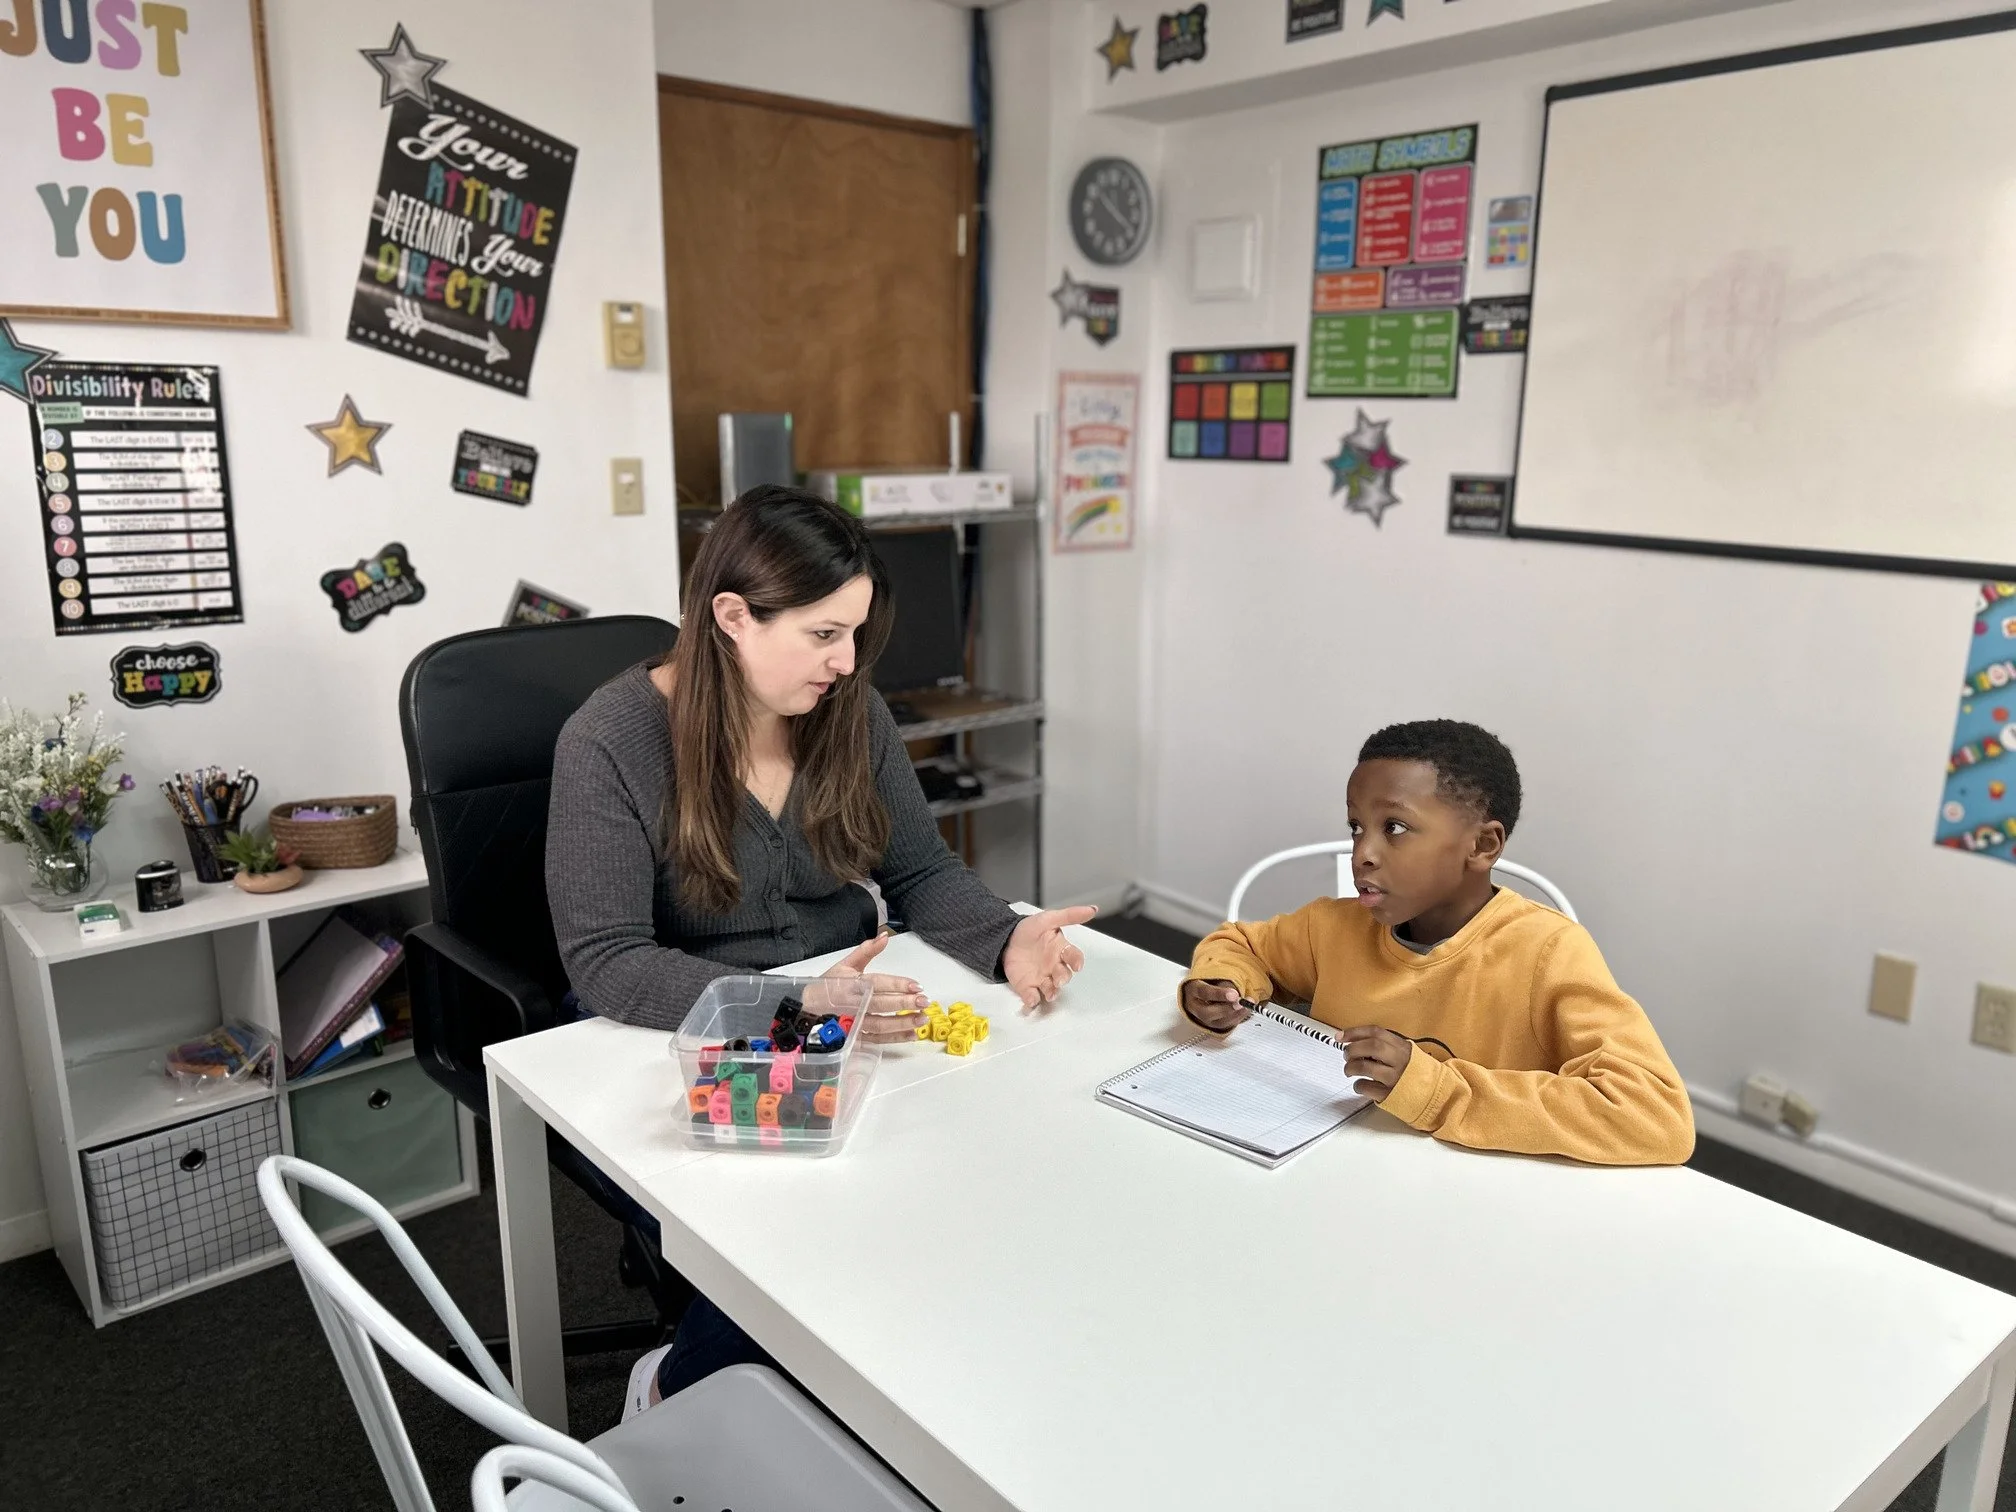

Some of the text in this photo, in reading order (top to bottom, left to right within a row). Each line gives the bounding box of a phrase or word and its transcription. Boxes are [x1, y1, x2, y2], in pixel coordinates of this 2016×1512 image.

[0, 0, 188, 77] JUST
[51, 87, 153, 167] BE
[397, 114, 528, 180] Your
[426, 161, 555, 245] ATTITUDE
[36, 182, 186, 264] YOU
[381, 190, 544, 277] DETERMINES Your
[375, 242, 535, 329] DIRECTION
[33, 375, 205, 400] Divisibility Rules
[55, 497, 64, 510] 5
[57, 519, 66, 531] 6
[60, 541, 69, 553] 7
[63, 562, 72, 574] 8
[66, 583, 75, 595] 9
[66, 603, 79, 615] 10
[135, 654, 198, 670] choose
